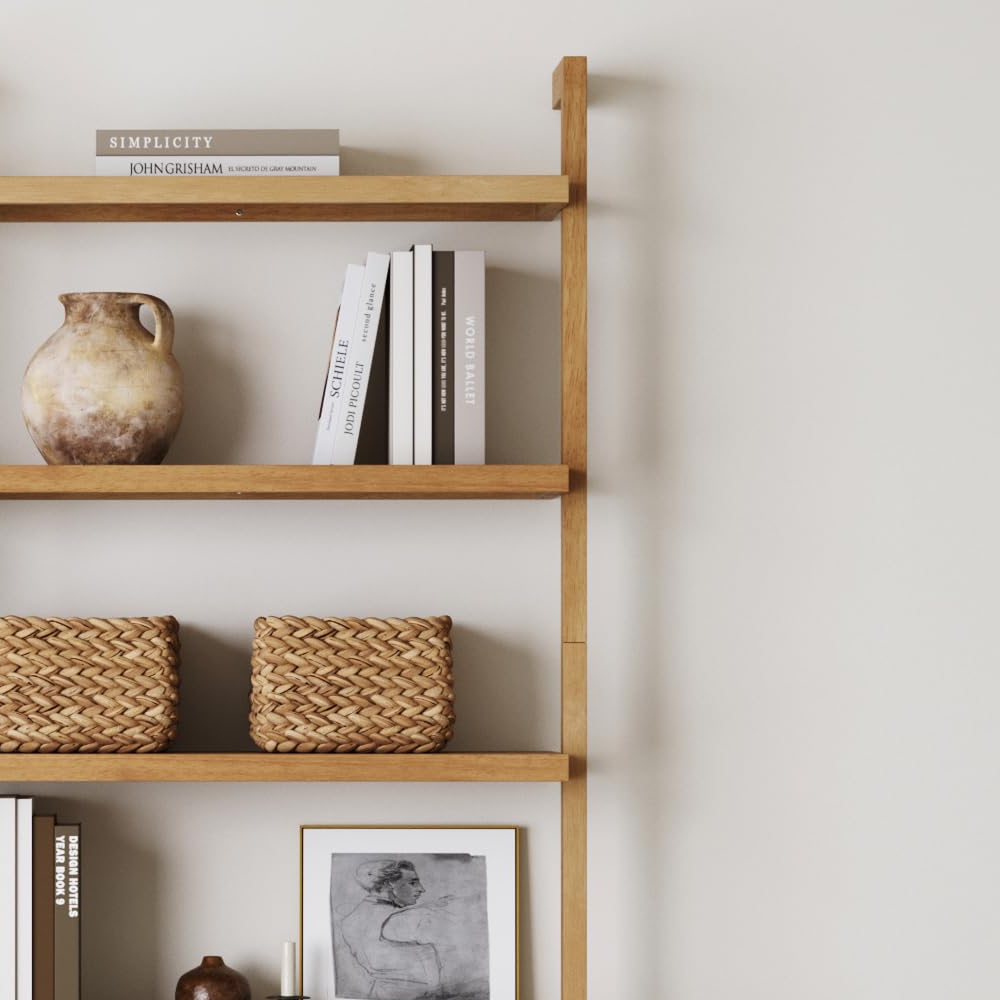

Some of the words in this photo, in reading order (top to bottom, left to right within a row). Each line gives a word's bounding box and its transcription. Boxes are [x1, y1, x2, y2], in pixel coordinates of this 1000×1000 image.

[109, 136, 214, 149] SIMPLICITY
[361, 313, 371, 342] second
[464, 316, 476, 359] WORLD
[330, 339, 349, 398] SCHIELE
[348, 360, 365, 408] PICOULT
[464, 363, 476, 407] BALLET
[343, 410, 356, 435] JODI
[55, 835, 66, 864] YEAR
[68, 835, 79, 876] DESIGN
[55, 865, 66, 897] BOOK
[68, 877, 79, 918] HOTELS
